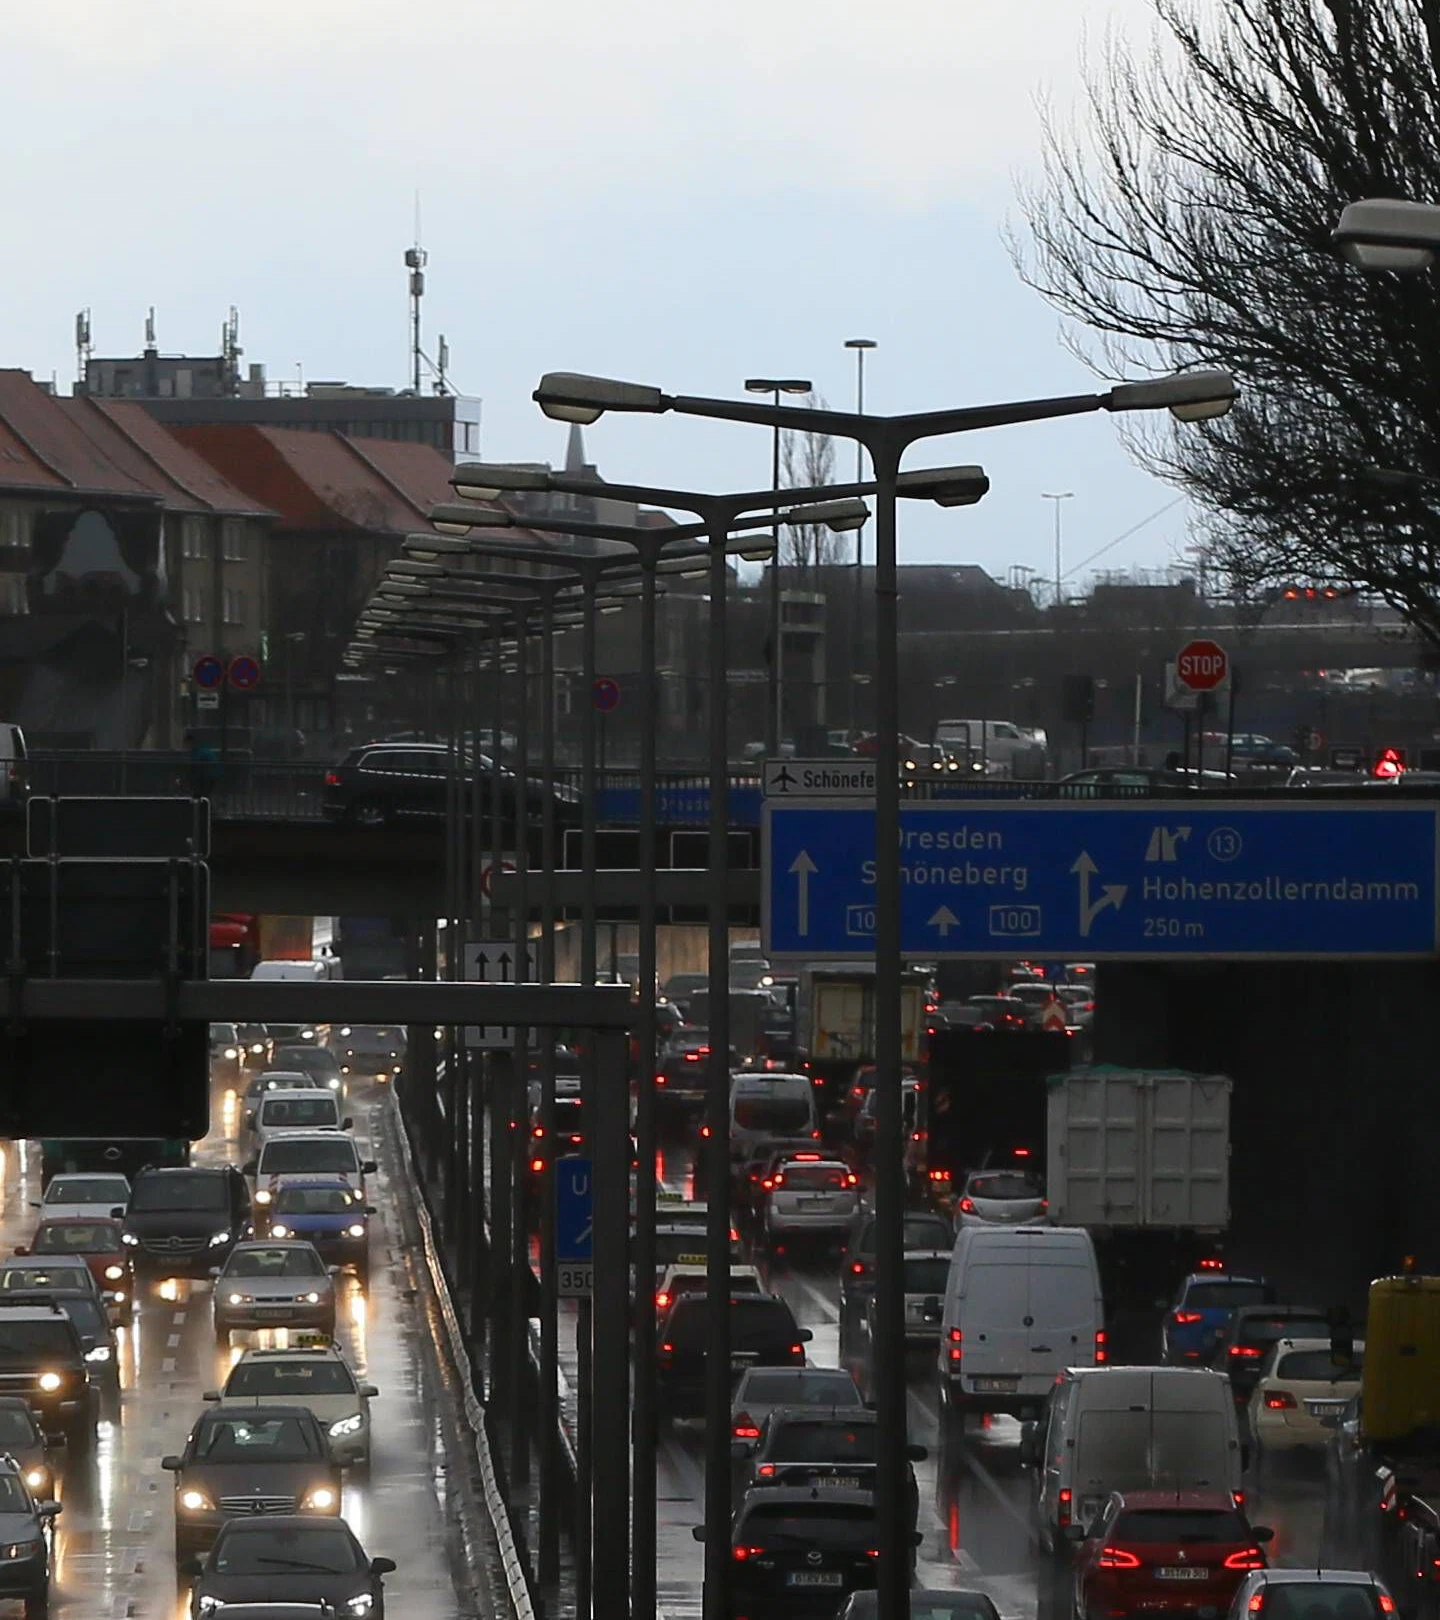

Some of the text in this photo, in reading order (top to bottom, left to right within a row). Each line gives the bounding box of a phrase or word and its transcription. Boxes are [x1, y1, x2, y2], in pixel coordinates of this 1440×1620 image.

[1181, 655, 1221, 675] STOP
[803, 769, 875, 788] Schönefe
[1215, 834, 1235, 854] 13
[861, 860, 1028, 892] Söneberg
[1142, 877, 1420, 901] Hohenzollerndamm
[855, 912, 878, 930] 10
[999, 912, 1032, 930] 100
[1143, 918, 1205, 937] 250 m
